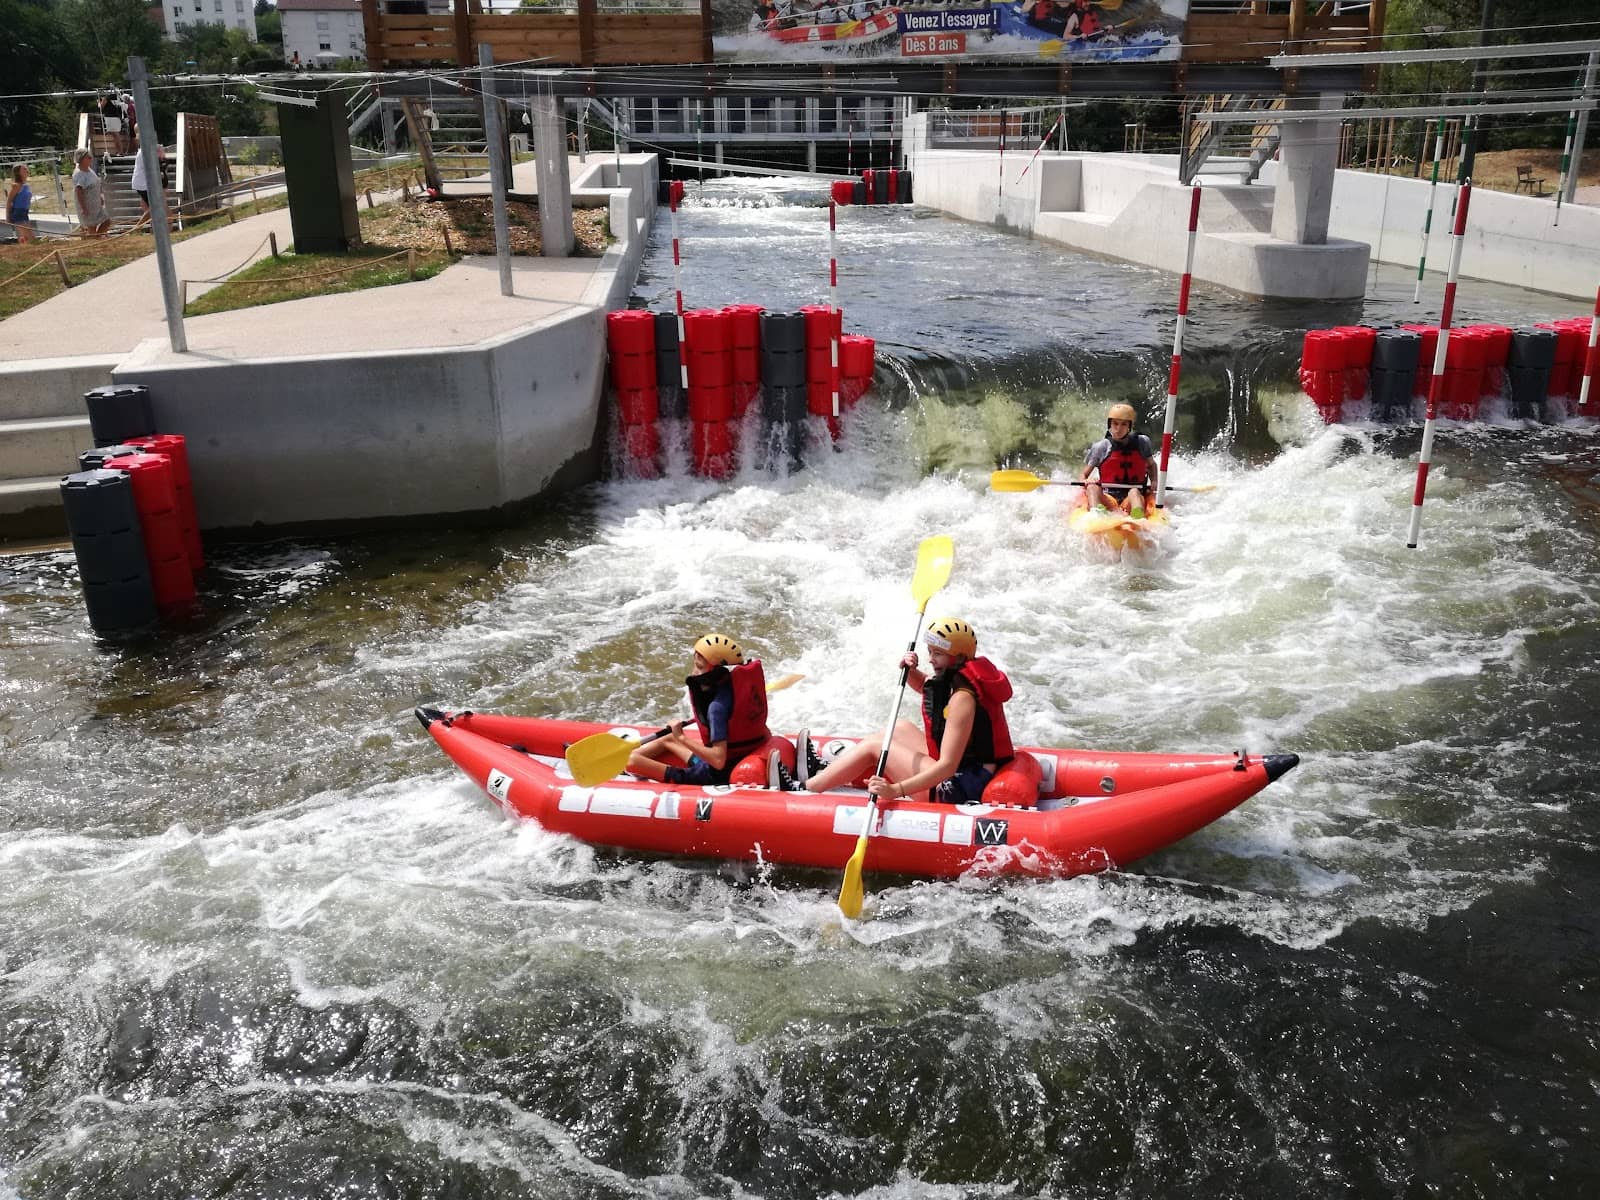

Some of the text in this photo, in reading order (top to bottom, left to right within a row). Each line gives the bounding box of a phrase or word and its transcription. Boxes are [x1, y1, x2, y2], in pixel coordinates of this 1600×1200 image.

[905, 9, 997, 29] Venez l'essayer !
[905, 36, 959, 53] Dès 8 ans
